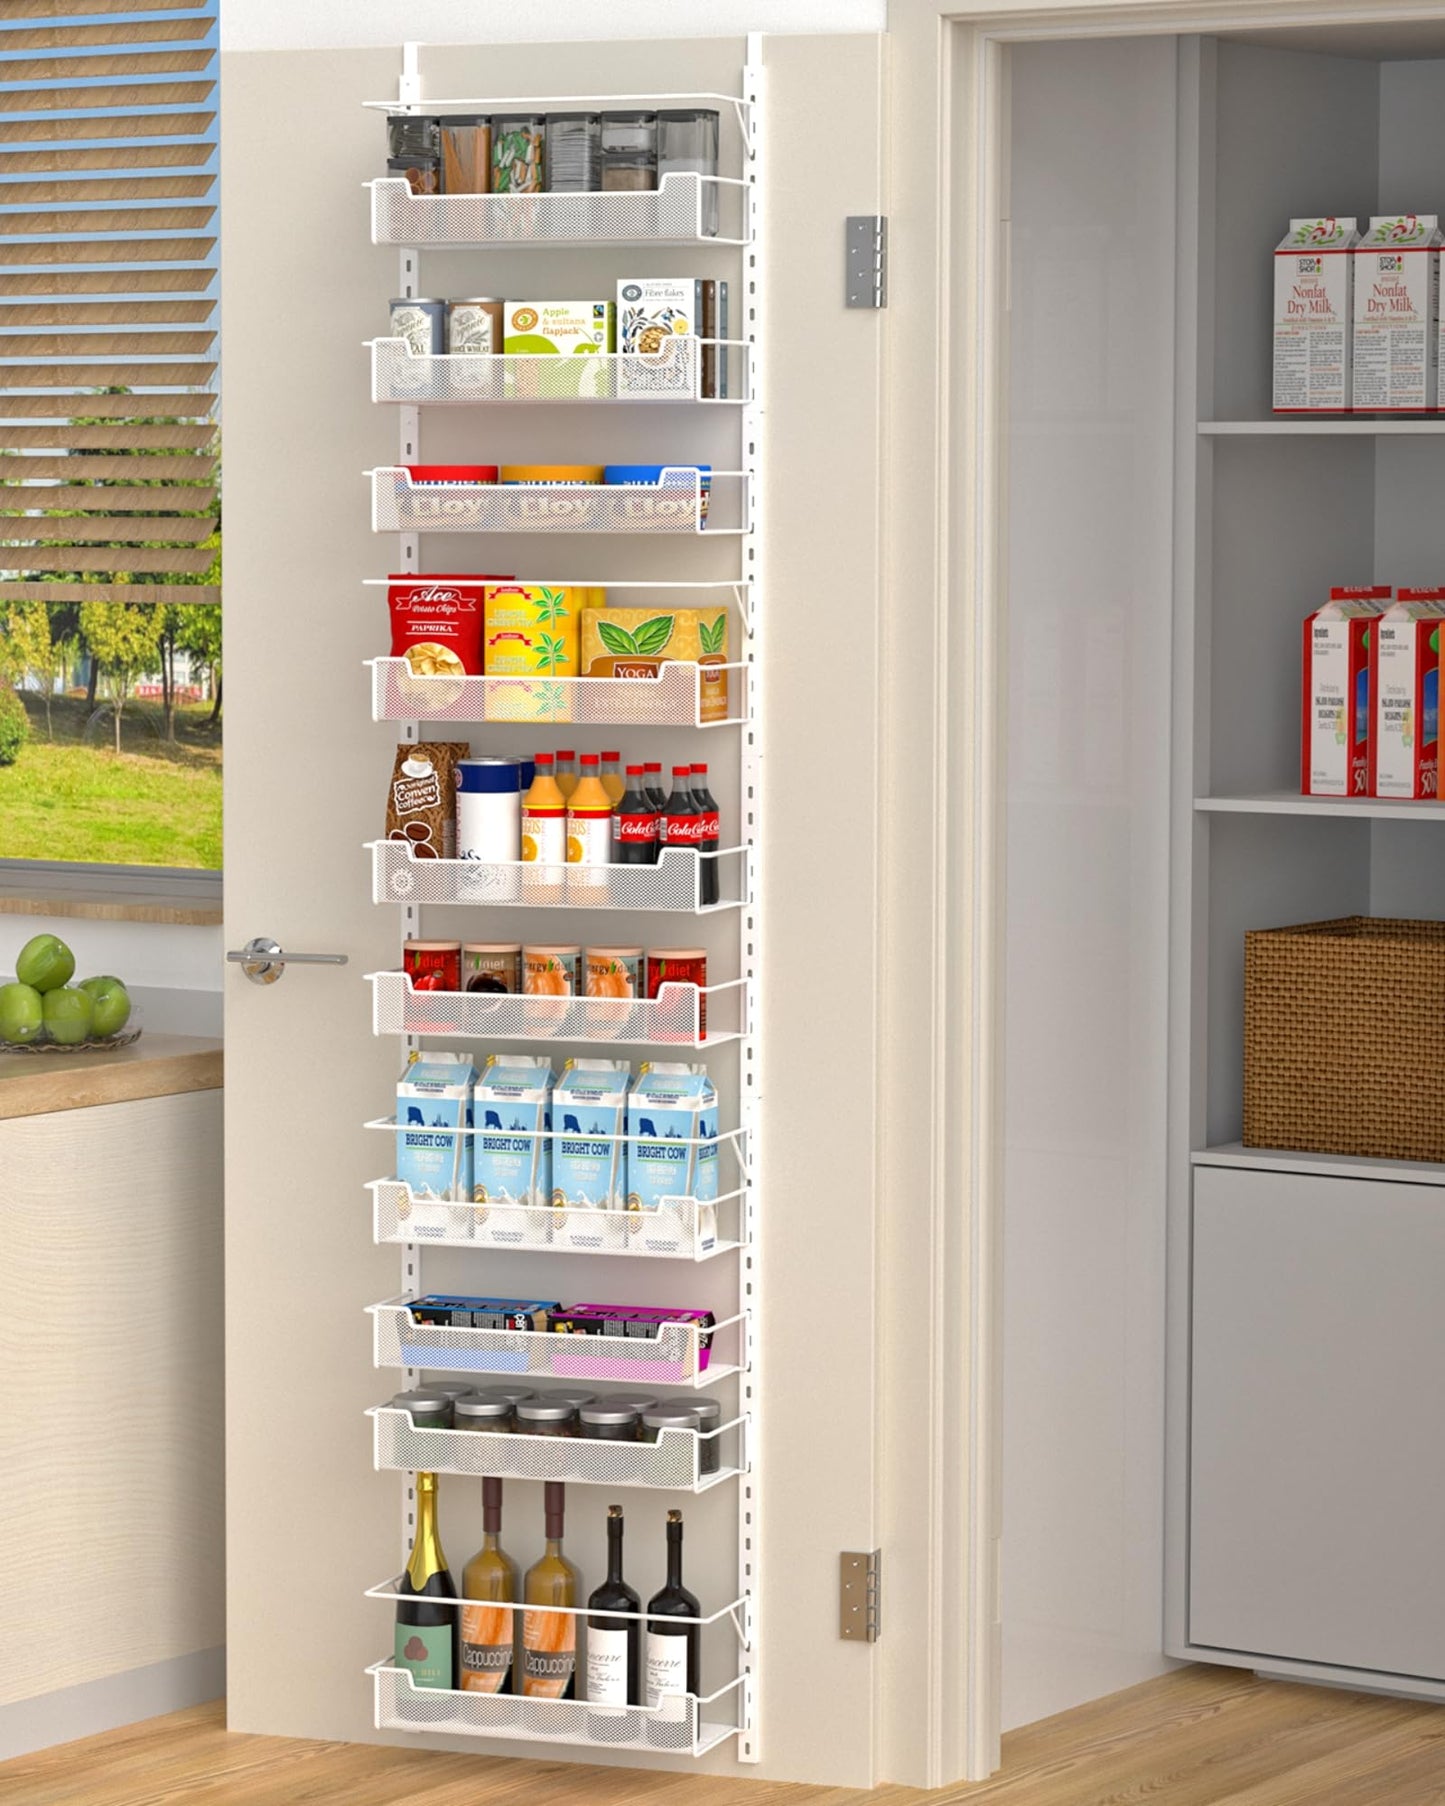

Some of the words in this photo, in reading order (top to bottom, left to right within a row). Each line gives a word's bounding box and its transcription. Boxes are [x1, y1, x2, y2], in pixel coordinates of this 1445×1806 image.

[1293, 284, 1326, 298] Nonfat
[1373, 283, 1407, 297] Nonfat
[543, 308, 570, 318] Apple
[1288, 300, 1306, 318] Dry
[1309, 298, 1332, 314] Milk
[1368, 299, 1386, 317] Dry
[1390, 298, 1413, 312] Milk
[412, 585, 456, 602] Ace
[411, 624, 453, 632] PAPRIKA
[617, 666, 654, 678] YOGA
[405, 1133, 434, 1146] BRIGHT
[435, 1135, 453, 1148] COW
[483, 1137, 512, 1150] BRIGHT
[512, 1139, 531, 1152] COW
[561, 1142, 591, 1154] BRIGHT
[591, 1143, 610, 1156] COW
[637, 1145, 666, 1158] BRIGHT
[667, 1147, 686, 1160] COW
